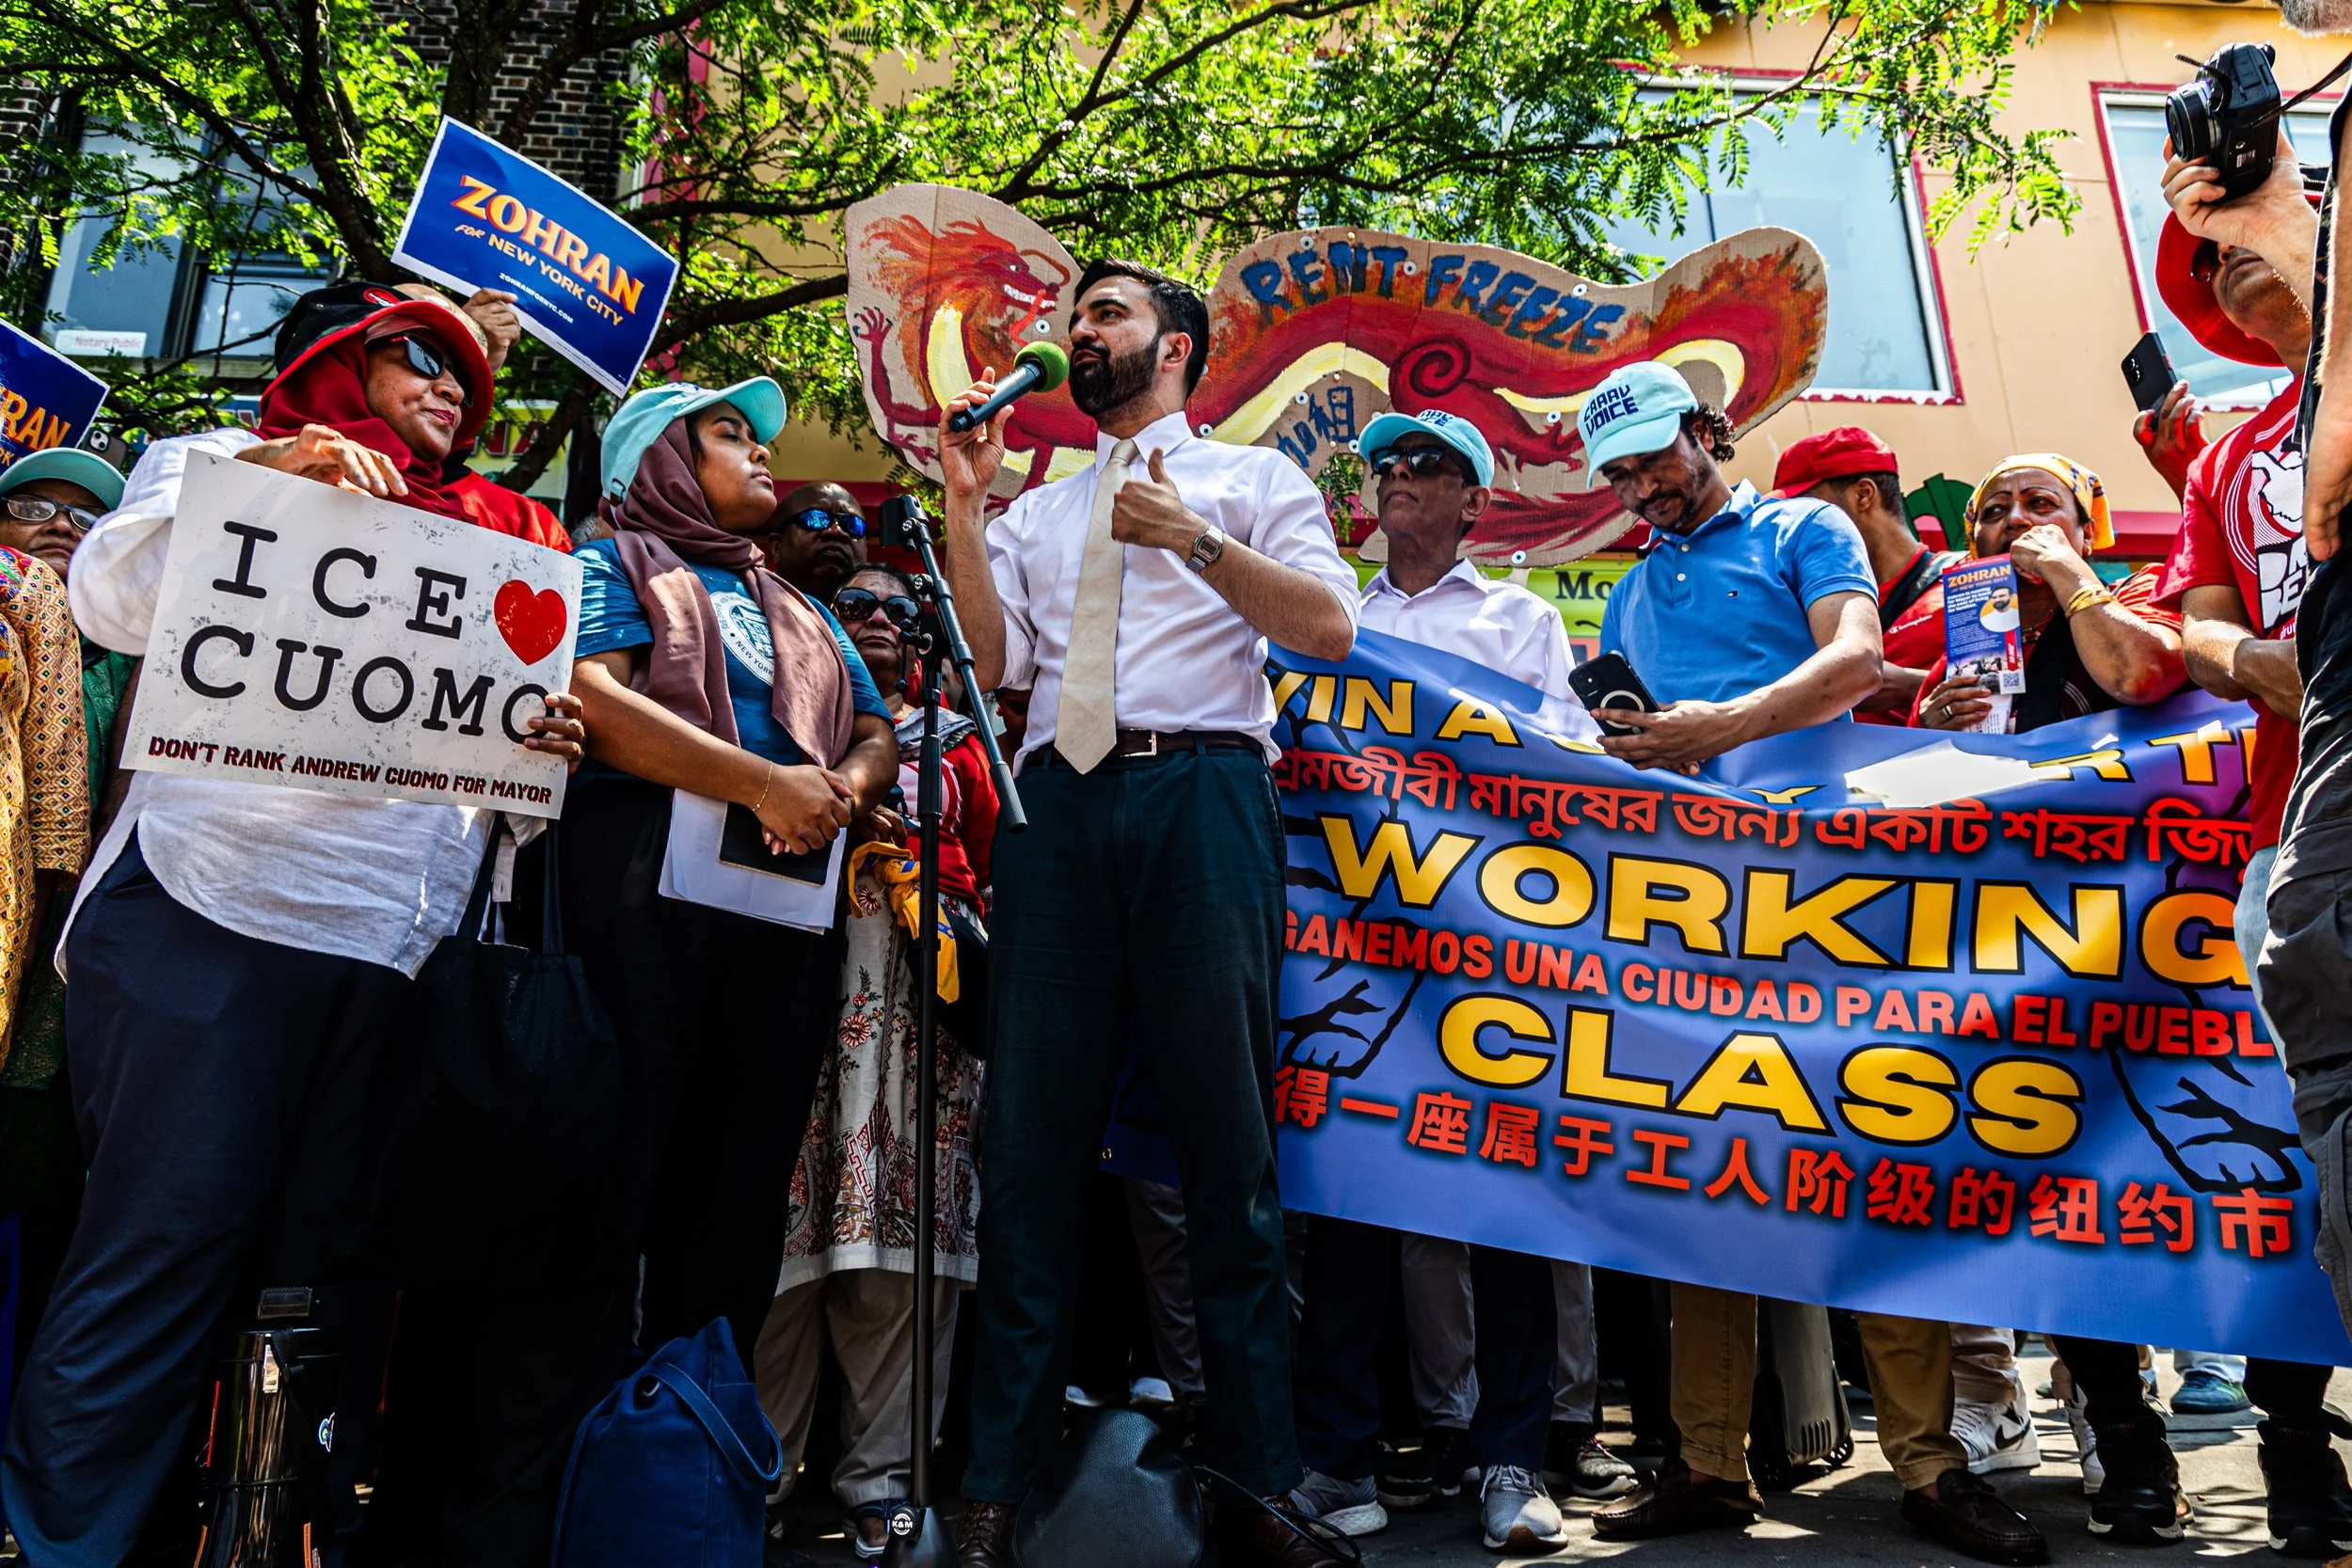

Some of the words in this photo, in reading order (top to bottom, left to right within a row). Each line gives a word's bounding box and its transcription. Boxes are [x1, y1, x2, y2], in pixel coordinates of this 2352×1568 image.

[452, 176, 644, 315] ZOHRAN
[454, 224, 486, 239] FOR
[488, 233, 536, 267] NEW
[539, 260, 583, 301] YORK
[586, 294, 624, 326] CITY
[500, 272, 574, 325] ZOHRANFORNYC.COM
[1239, 240, 1409, 309] RENT
[1424, 254, 1626, 356] FREEZE
[74, 336, 110, 348] Notary
[111, 337, 141, 348] Public
[0, 385, 72, 451] RAN
[1585, 396, 1639, 439] VOICE
[212, 520, 468, 640] ICE
[1555, 571, 1613, 600] Mo
[1947, 564, 2011, 589] ZOHRAN
[181, 625, 556, 745] CUOMO
[736, 641, 754, 659] NEW
[754, 658, 774, 678] YORK
[1434, 689, 1525, 749] A
[148, 736, 219, 766] DON'T
[223, 744, 287, 772] RANK
[291, 755, 382, 784] ANDREW
[384, 768, 449, 791] CUOMO
[452, 774, 486, 797] FOR
[489, 781, 552, 806] MAYOR
[1468, 773, 1662, 839] মানুষের
[1671, 792, 1804, 848] জন্য
[1816, 797, 1993, 854] একটি
[2001, 808, 2134, 863] শহর
[1314, 811, 2251, 992] WORKING
[1505, 939, 1608, 995] UNA
[1622, 963, 1823, 1024] CIUDAD
[1836, 986, 1999, 1040] PARA
[2012, 993, 2076, 1046] EL
[2090, 1002, 2275, 1057] PUEBL
[1437, 992, 2086, 1161] CLASS
[892, 1520, 913, 1528] K&M
